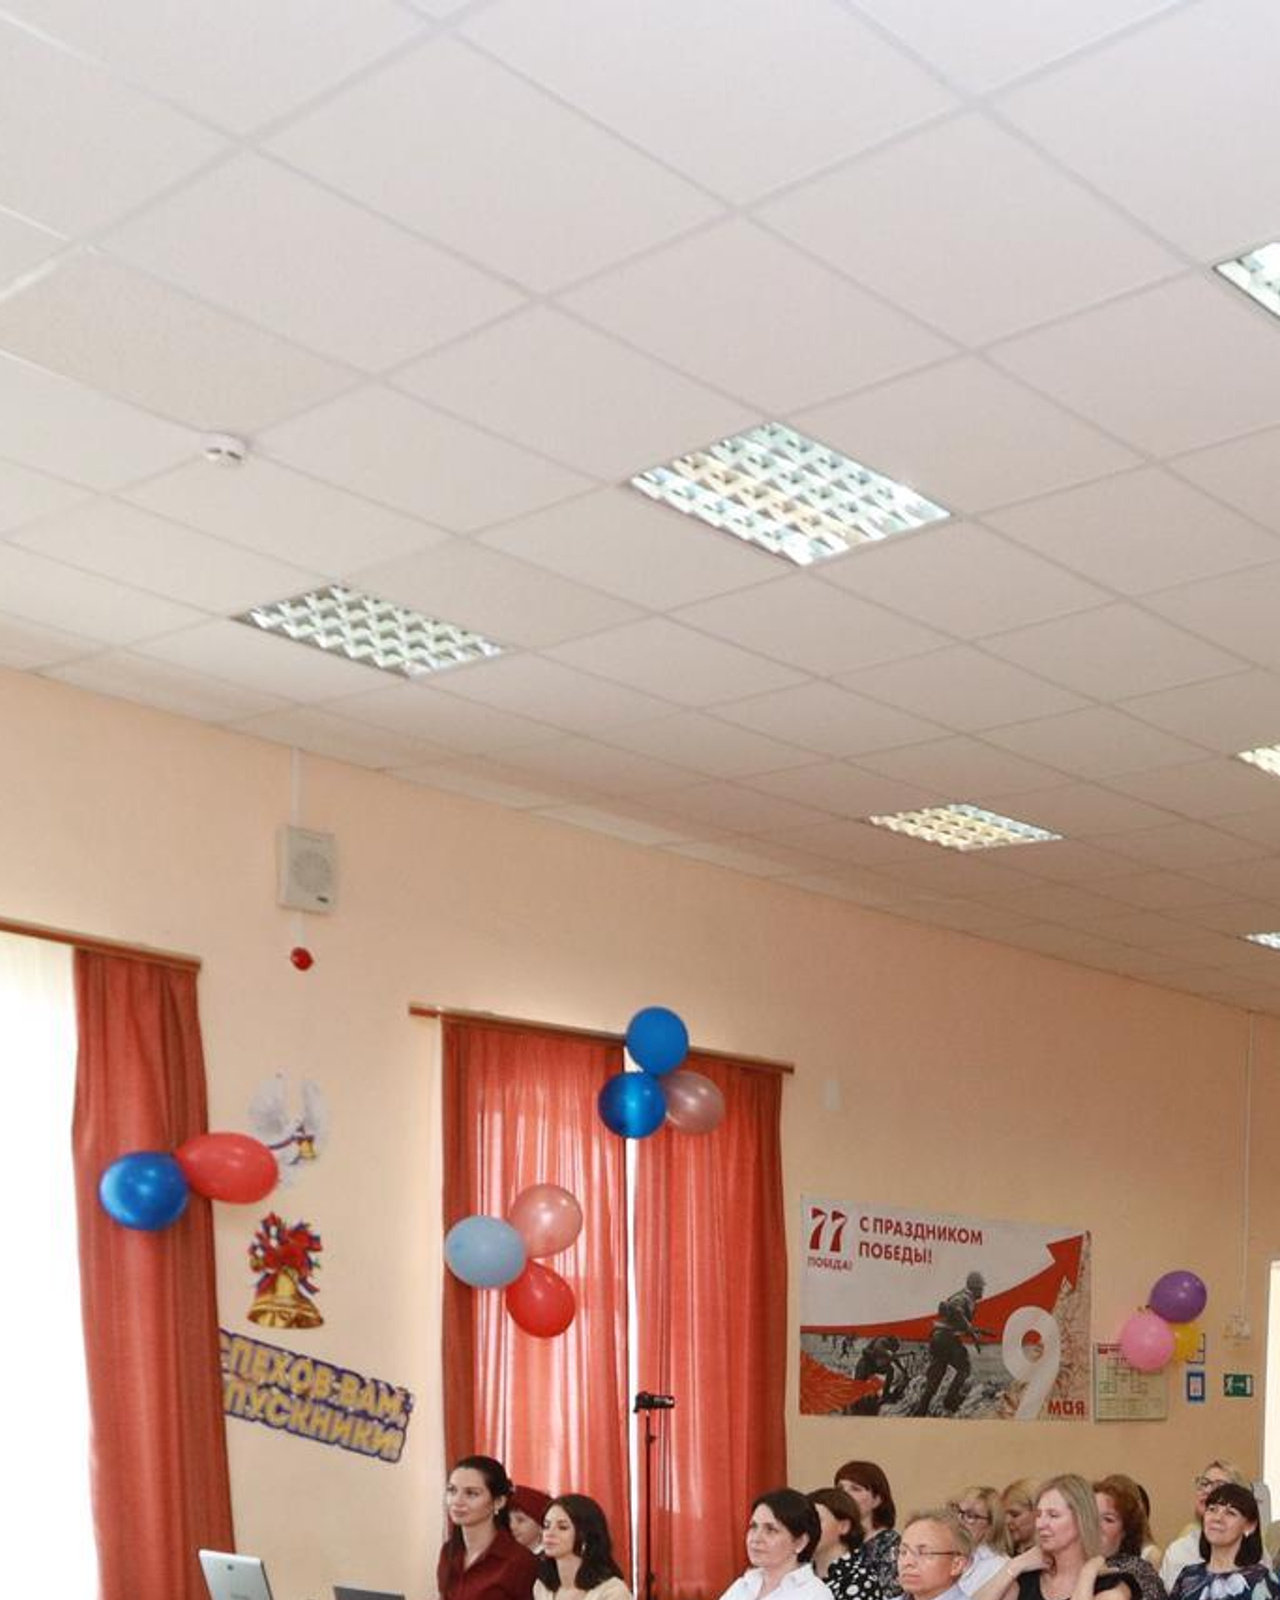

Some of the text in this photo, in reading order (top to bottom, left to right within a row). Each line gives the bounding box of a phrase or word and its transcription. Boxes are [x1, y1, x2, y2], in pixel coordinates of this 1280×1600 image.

[809, 1207, 848, 1252] 77
[859, 1217, 984, 1246] С ПРАЗДНИКОМ
[858, 1241, 933, 1265] ПОБЕДЫ!
[1002, 1306, 1060, 1419] 9
[223, 1379, 402, 1455] ПУСКНИКИ
